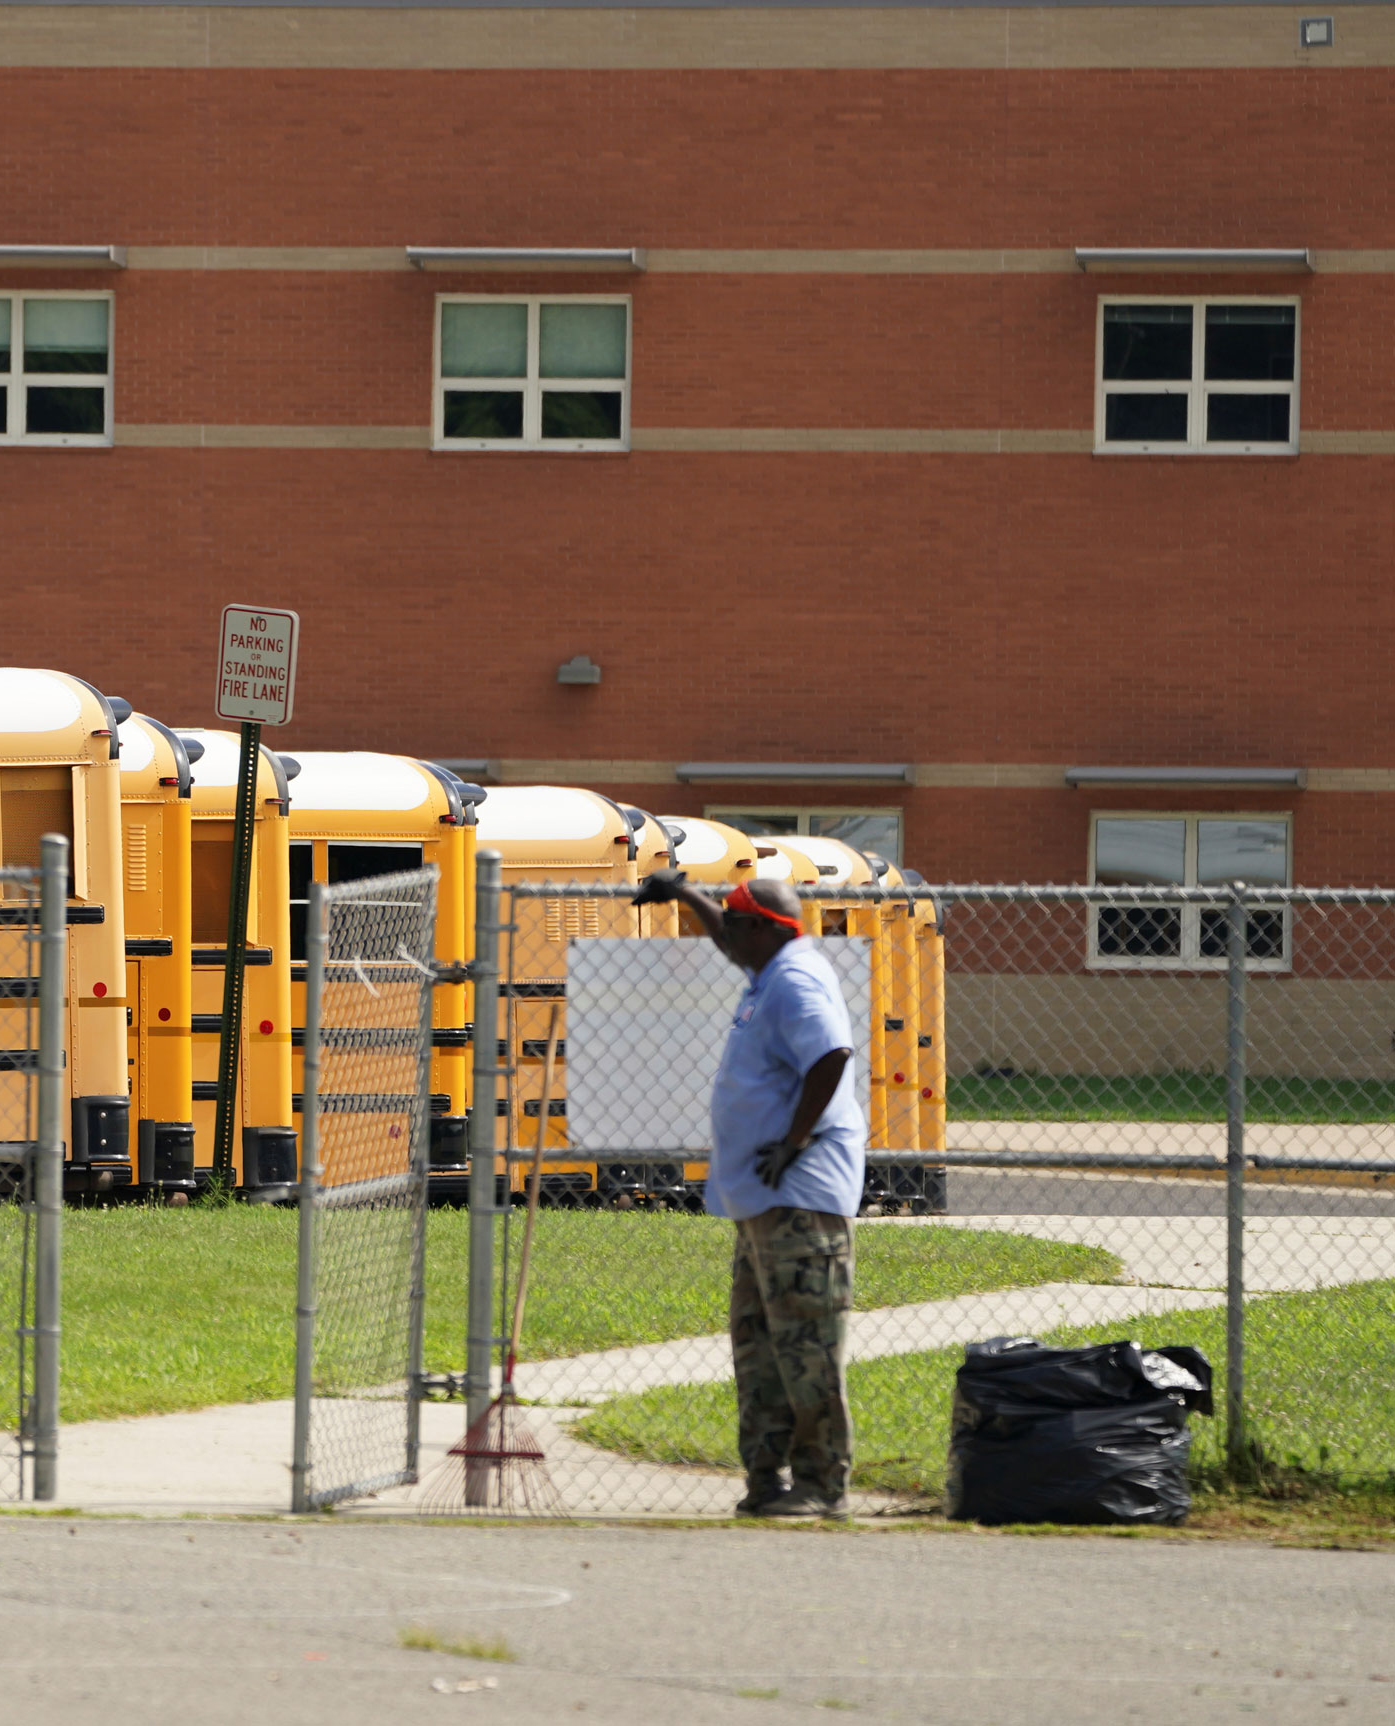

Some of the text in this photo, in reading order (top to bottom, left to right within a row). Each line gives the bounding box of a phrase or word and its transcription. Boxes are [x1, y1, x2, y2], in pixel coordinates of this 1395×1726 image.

[250, 617, 267, 632] NO
[230, 634, 284, 652] PARKING
[250, 653, 262, 661] OR
[225, 661, 286, 681] STANDING
[222, 679, 285, 702] FIRE LANE
